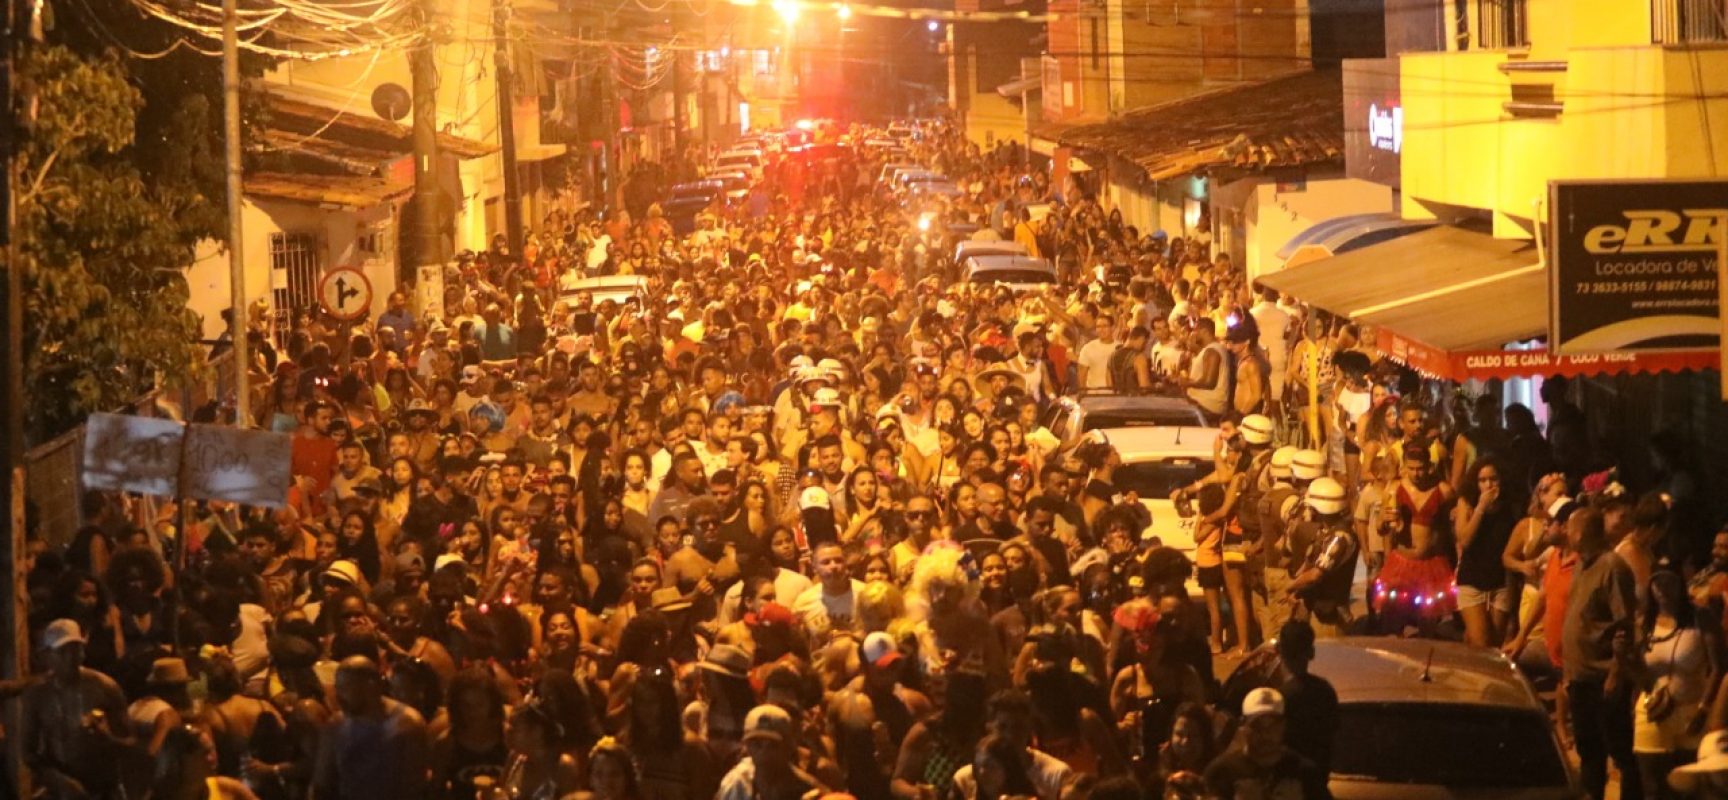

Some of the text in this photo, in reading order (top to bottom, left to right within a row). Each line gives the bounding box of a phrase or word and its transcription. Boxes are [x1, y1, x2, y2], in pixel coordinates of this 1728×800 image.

[1595, 259, 1672, 276] Locadora
[1676, 259, 1698, 273] de
[1576, 281, 1590, 294] 73
[1466, 355, 1502, 368] CALDO
[1504, 354, 1518, 367] DE
[1520, 353, 1550, 366] CANA
